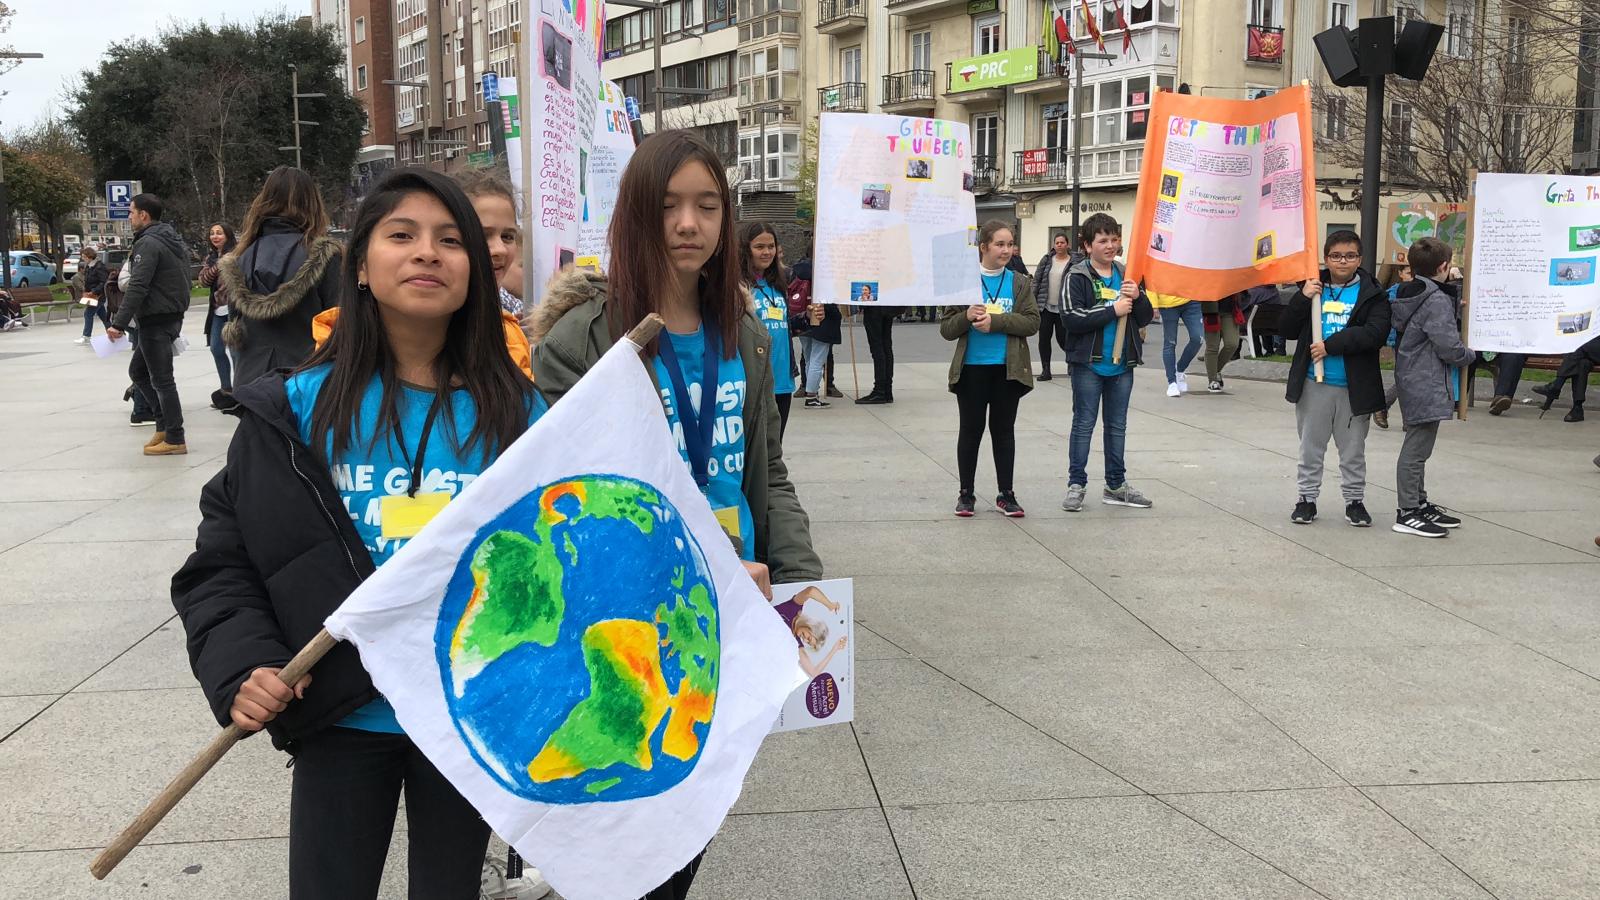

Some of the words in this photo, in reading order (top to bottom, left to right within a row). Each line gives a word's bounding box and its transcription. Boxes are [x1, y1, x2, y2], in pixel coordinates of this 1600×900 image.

[980, 60, 1008, 80] PRC
[900, 118, 951, 138] GRETA
[112, 185, 127, 202] P
[1546, 182, 1575, 204] Greta
[1089, 202, 1112, 212] ROMA
[811, 681, 819, 715] Mensual
[826, 678, 835, 710] NUEVO
